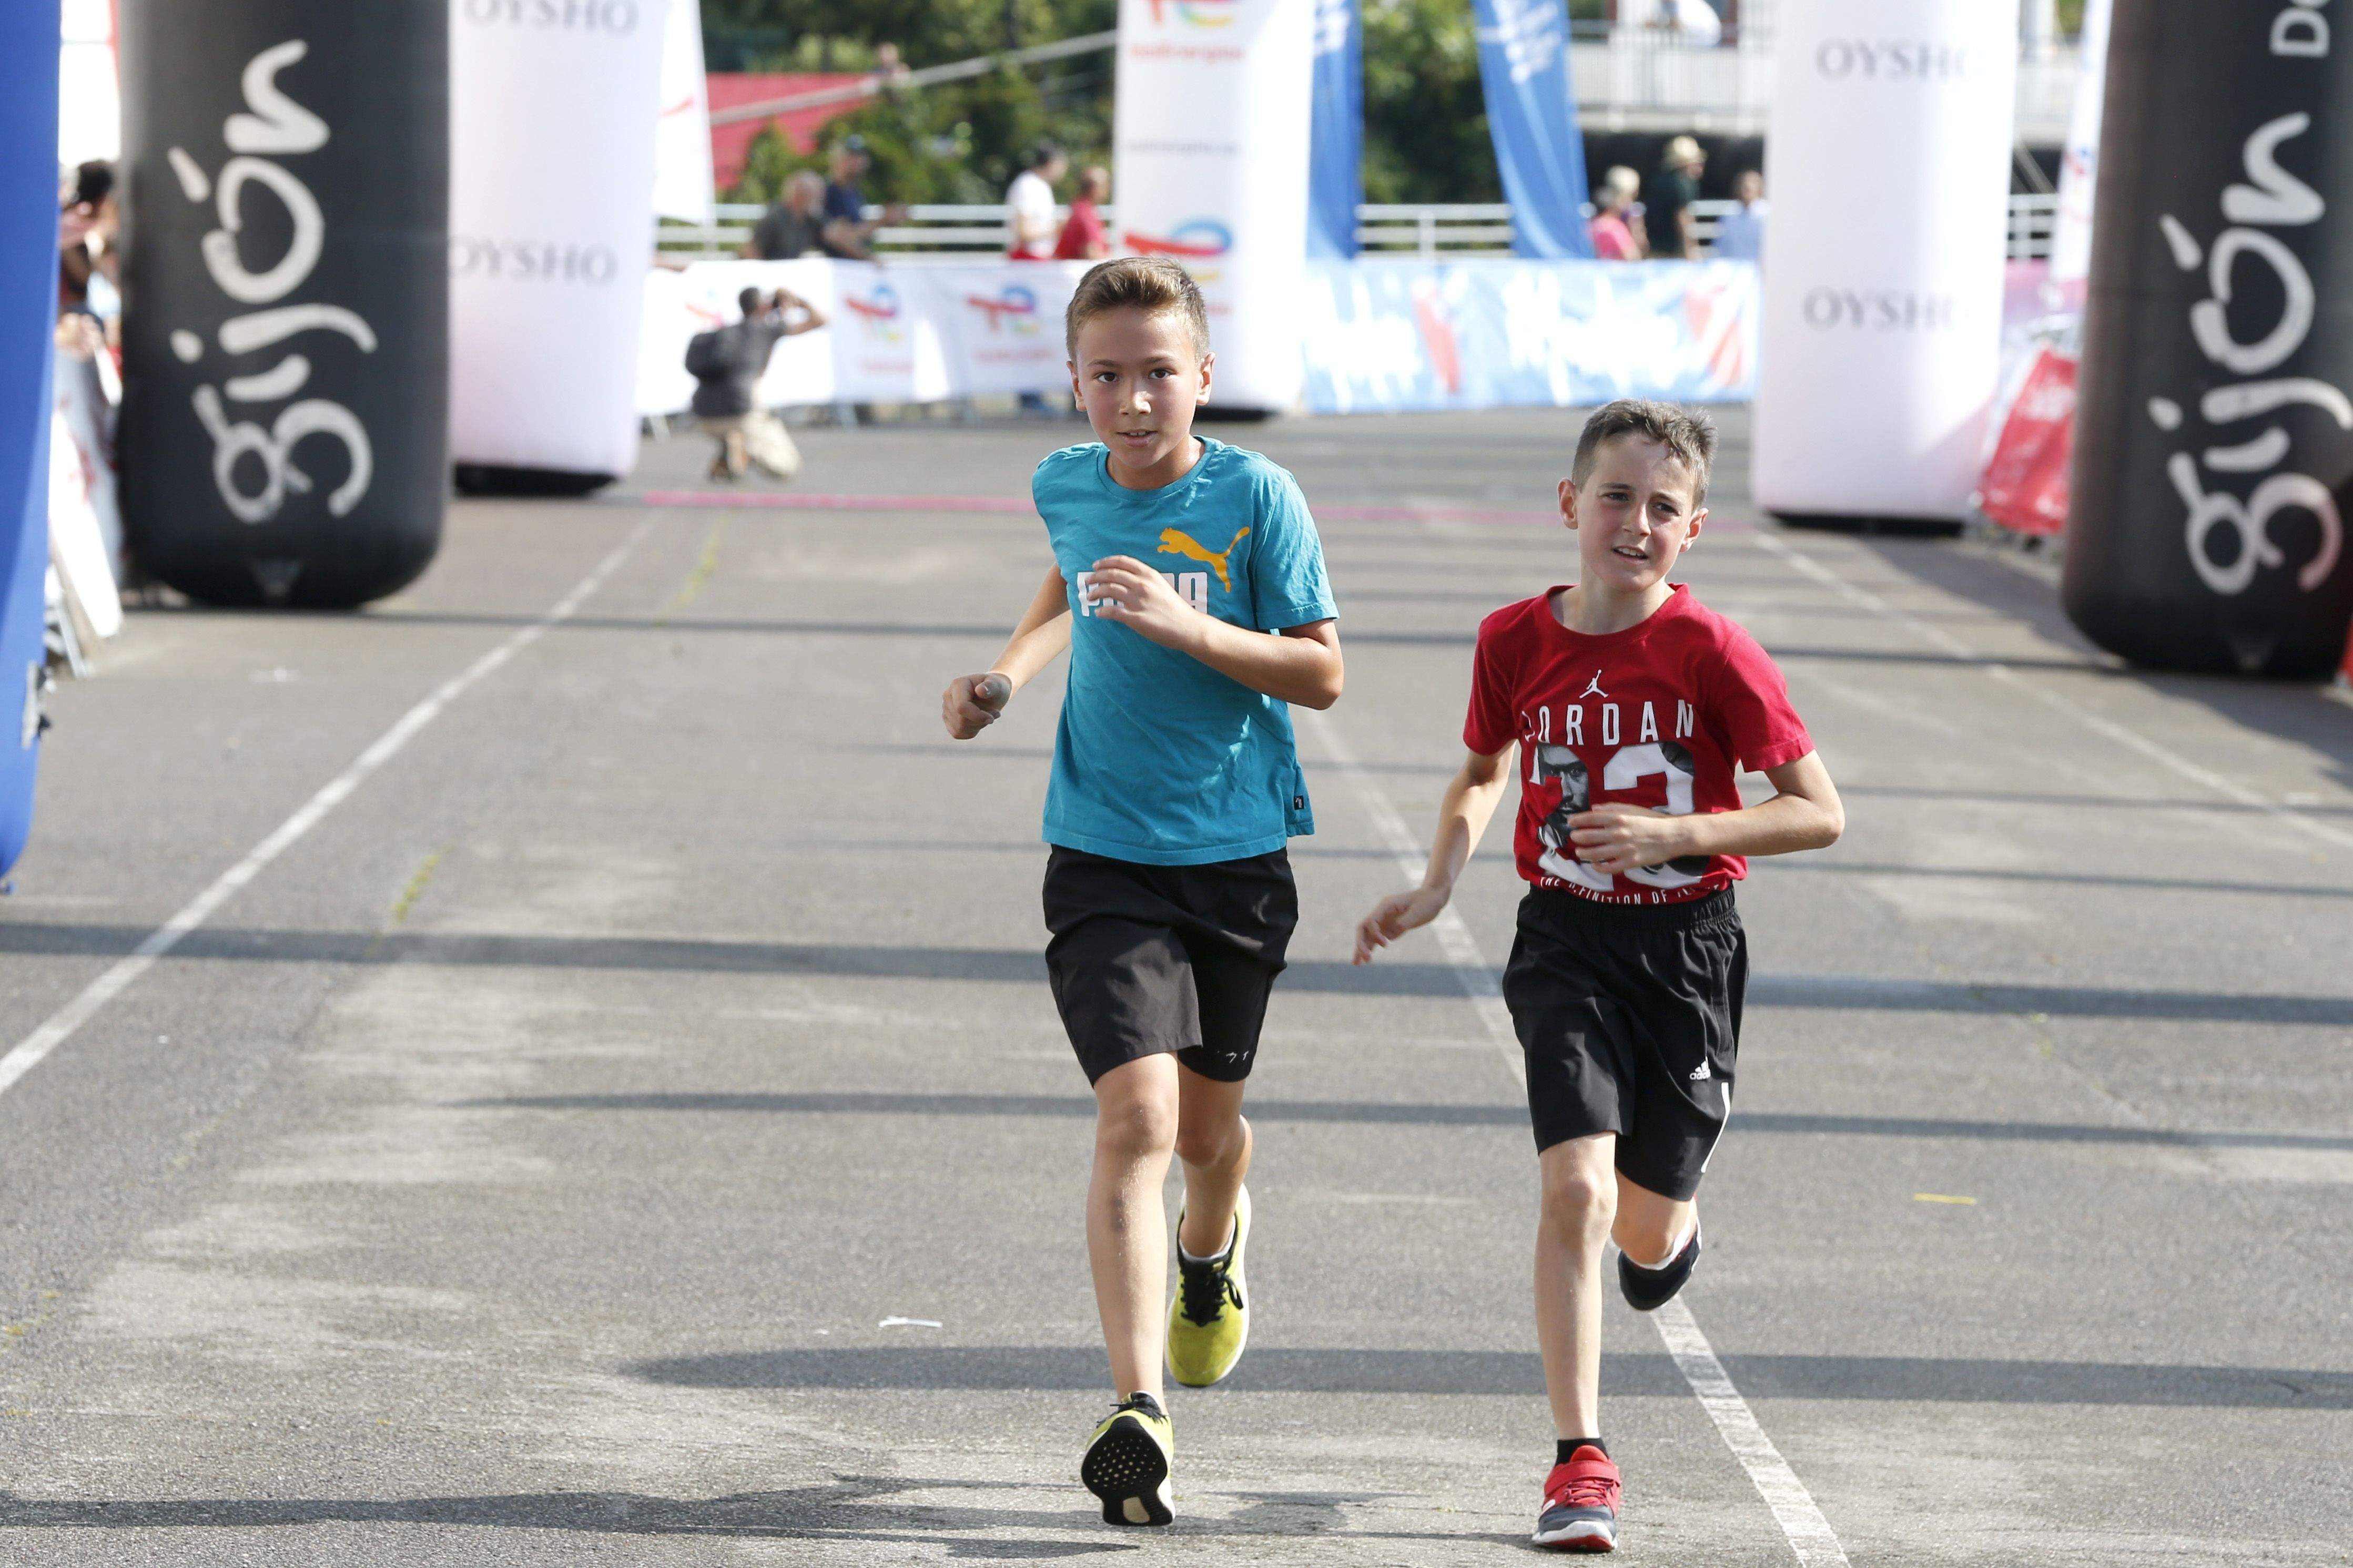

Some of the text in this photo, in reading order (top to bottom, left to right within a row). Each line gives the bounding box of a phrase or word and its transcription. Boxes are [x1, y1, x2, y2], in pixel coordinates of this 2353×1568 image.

[2269, 0, 2331, 58] D
[1803, 286, 1954, 332] OYSH
[1077, 571, 1208, 617] PA
[1568, 883, 1641, 905] FINITION
[1651, 889, 1667, 904] OF
